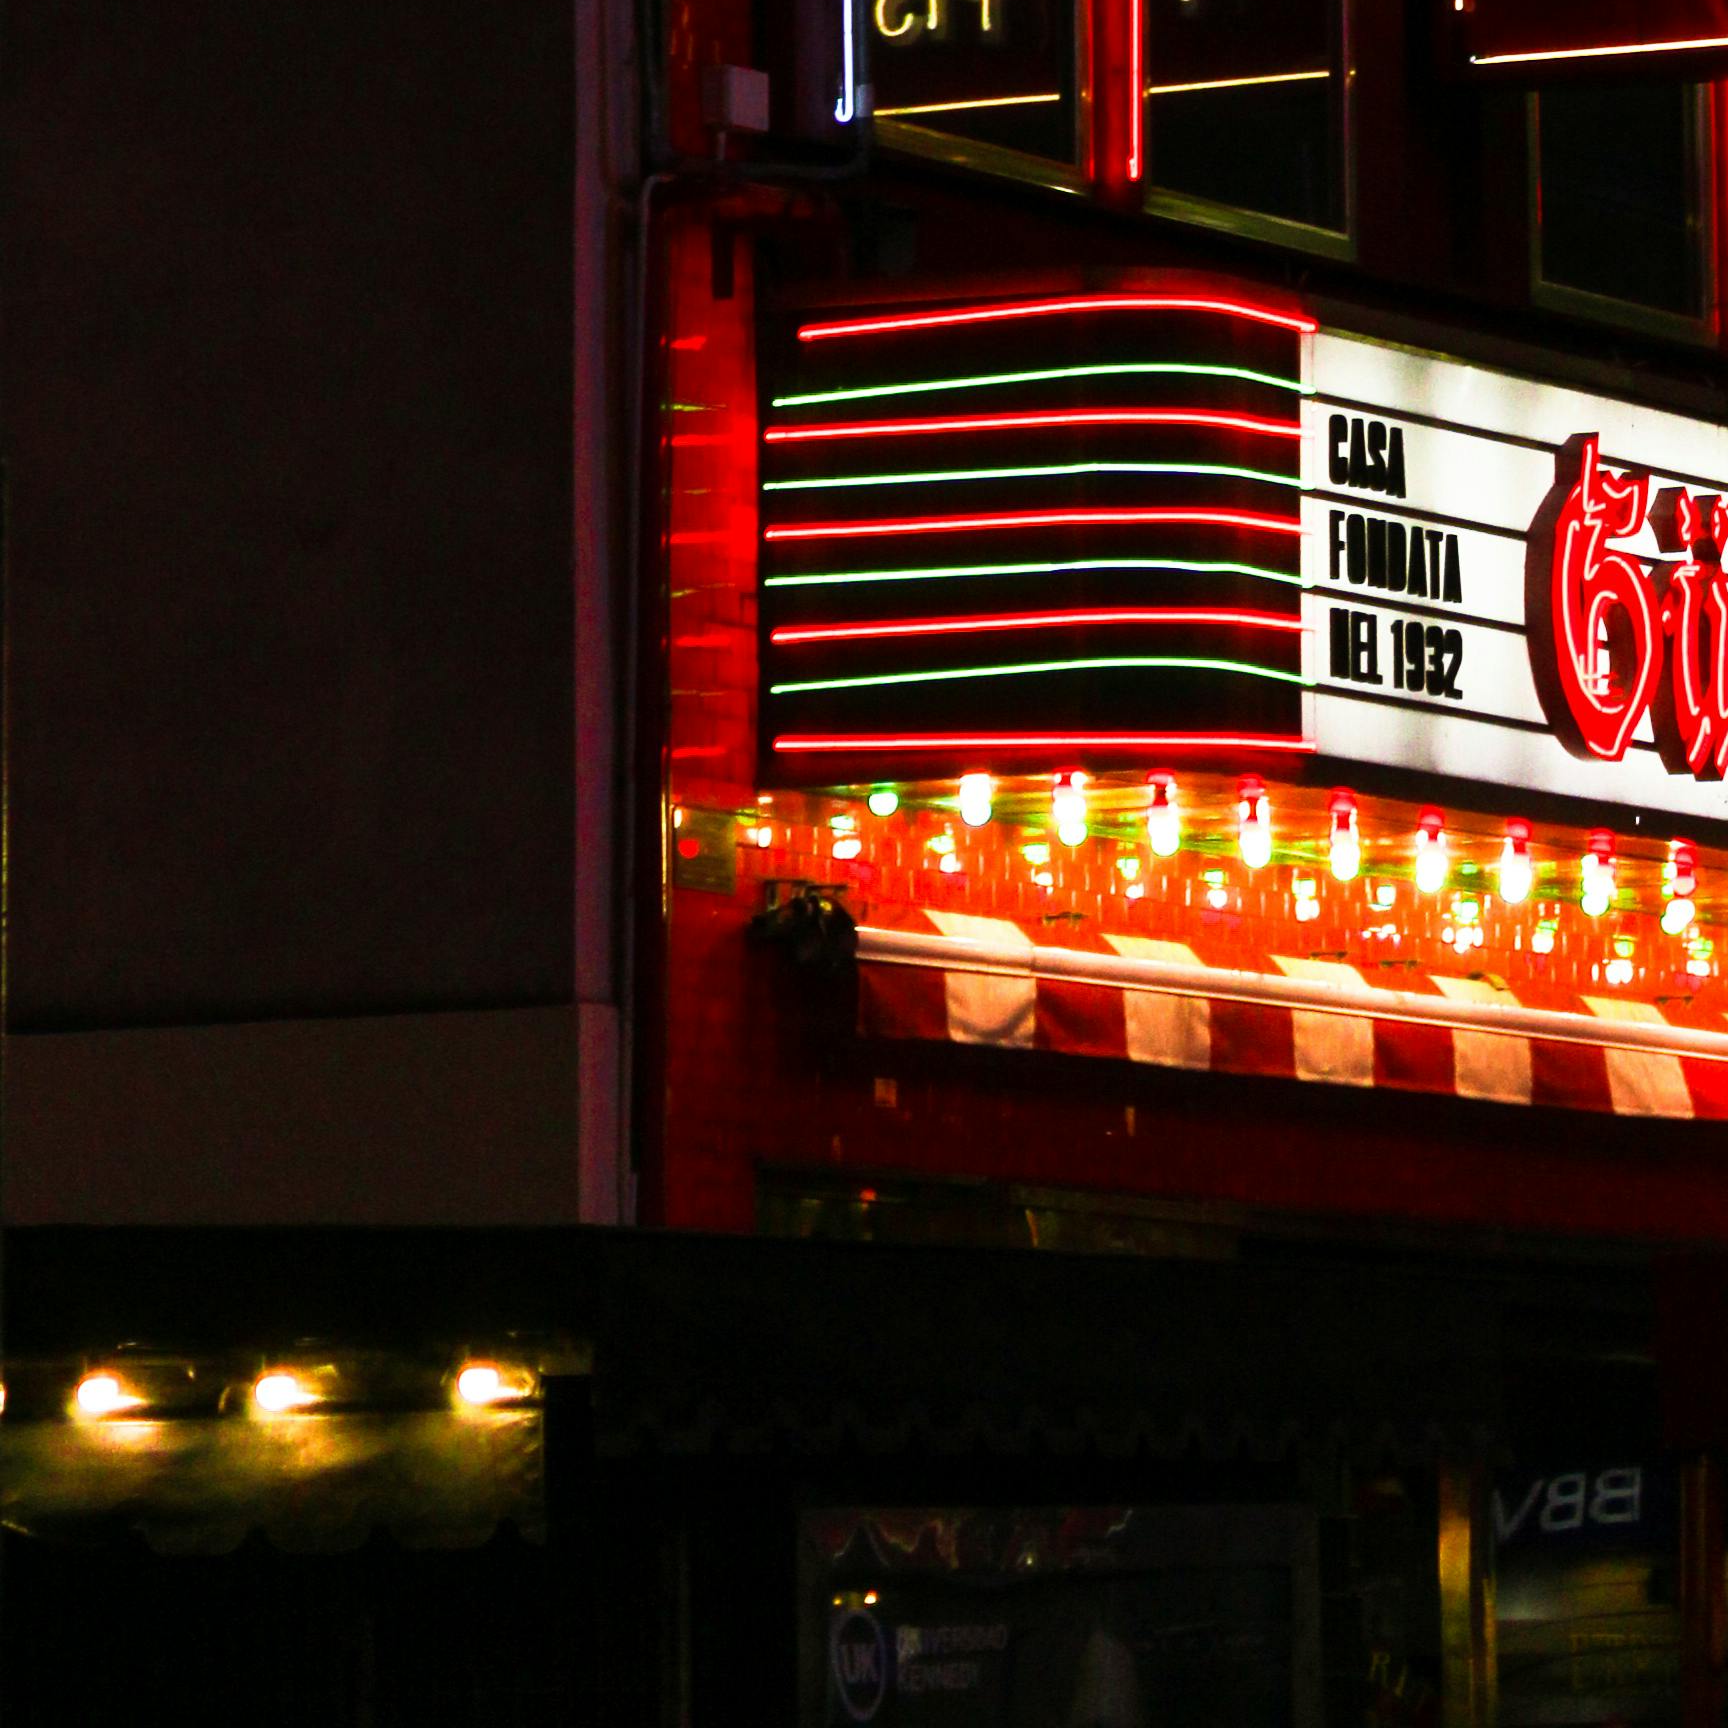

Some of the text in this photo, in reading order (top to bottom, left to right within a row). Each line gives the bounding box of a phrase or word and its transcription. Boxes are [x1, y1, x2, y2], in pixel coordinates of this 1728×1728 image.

[1328, 414, 1407, 499] CASA
[1329, 510, 1463, 603] FONDATA
[1329, 607, 1463, 699] NEL 1932
